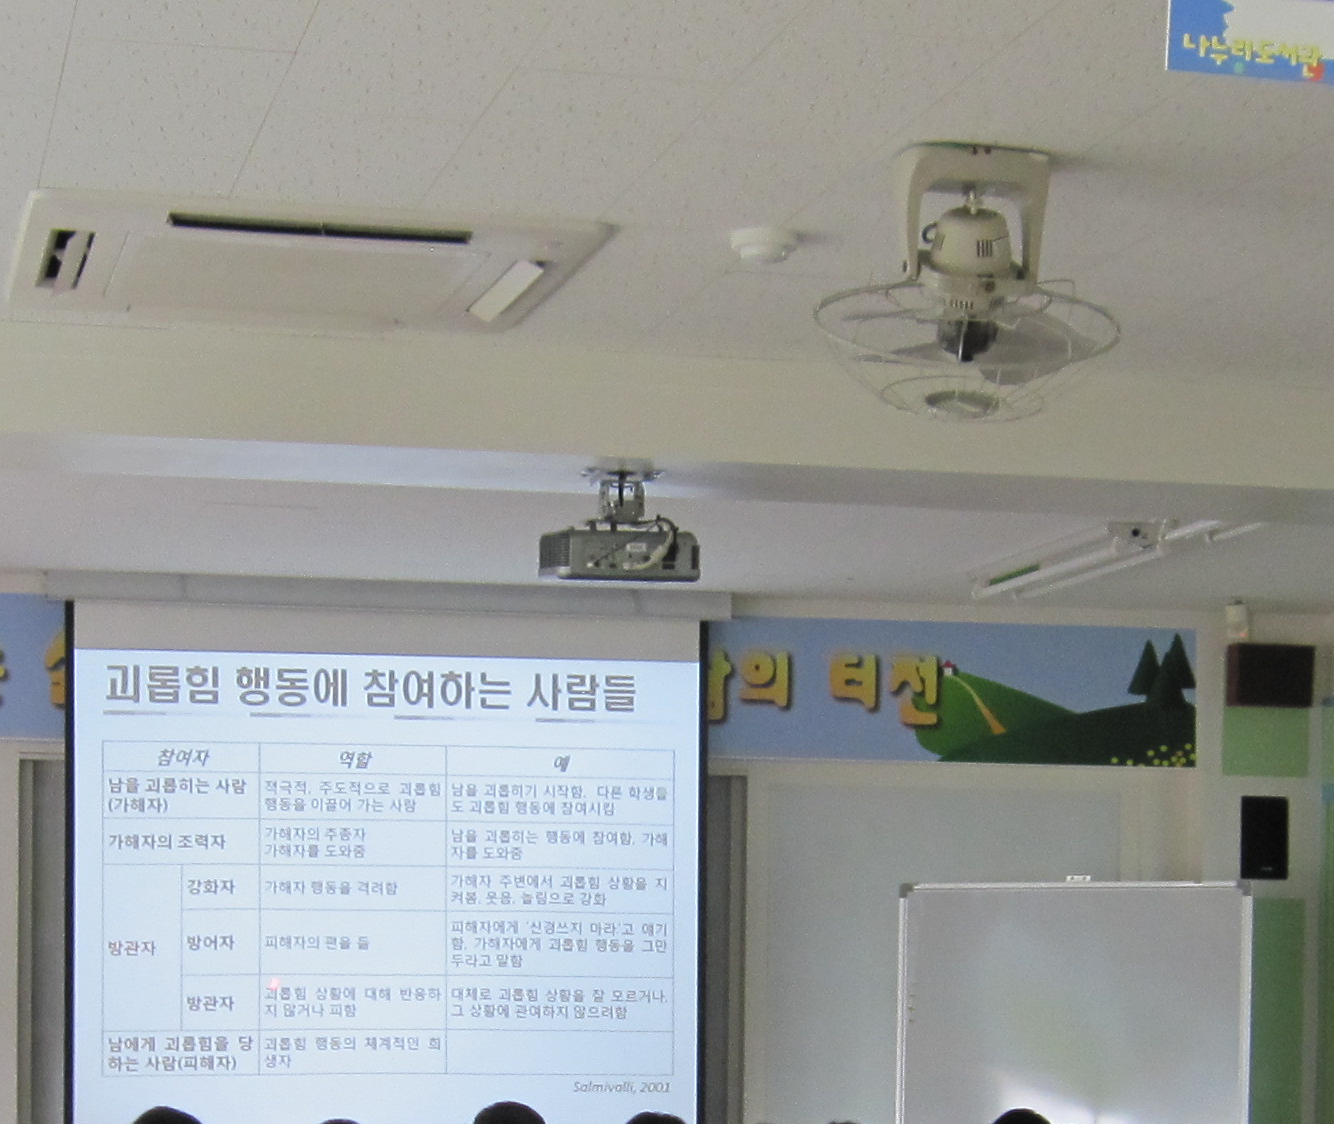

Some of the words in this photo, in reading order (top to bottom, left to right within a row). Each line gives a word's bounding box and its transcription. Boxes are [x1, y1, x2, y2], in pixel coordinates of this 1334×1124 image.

[106, 665, 218, 704] 괴롭힘
[236, 667, 347, 707] 행동에
[364, 669, 511, 710] 참여하는
[527, 673, 636, 712] 사람들
[829, 651, 939, 726] 터전
[158, 749, 210, 767] 참여자
[340, 751, 373, 769] 역할
[554, 756, 570, 772] 예
[109, 778, 139, 793] 남을
[145, 778, 209, 794] 괴롭히는
[216, 778, 246, 794] 사람
[319, 782, 390, 795] 주도적으로
[400, 783, 440, 796] 괴롭힘
[452, 784, 477, 797] 남을
[485, 784, 536, 798] 괴롭히기
[597, 786, 622, 799] 다른
[629, 786, 667, 800] 학생들
[108, 797, 168, 813] (가해자)
[265, 798, 306, 811] 행동을
[311, 798, 351, 812] 이끌어
[358, 799, 383, 812] 가는
[390, 799, 416, 813] 사람
[451, 801, 463, 812] 도
[470, 801, 509, 814] 괴롭힘
[516, 801, 555, 815] 행동에
[562, 802, 614, 816] 참여시킴
[265, 827, 319, 841] 가해자의
[452, 829, 477, 842] 남을
[486, 830, 538, 844] 괴롭히는
[546, 831, 584, 844] 행동에
[643, 833, 667, 846] 가해
[109, 834, 172, 850] 가해자의
[178, 834, 226, 850] 조력자
[266, 844, 319, 858] 가해자를
[452, 846, 477, 859] 자를
[187, 879, 235, 895] 강화자
[266, 881, 305, 894] 가해자
[311, 881, 351, 895] 행동을
[358, 881, 397, 895] 격려함
[452, 875, 491, 888] 가해자
[500, 875, 552, 888] 주변에서
[561, 876, 599, 889] 괴롭힘
[609, 876, 647, 890] 상황을
[656, 878, 667, 891] 지
[581, 893, 606, 906] 강화
[452, 921, 518, 934] 피해자에게
[108, 940, 156, 956] 방관자
[187, 935, 235, 951] 방어자
[265, 936, 319, 949] 피해자의
[325, 936, 351, 950] 편을
[475, 937, 541, 951] 가해자에게
[549, 938, 587, 952] 괴롭힘
[596, 939, 634, 952] 행동을
[642, 940, 667, 953] 그만
[451, 954, 491, 967] 두라고
[497, 954, 522, 968] 말함
[265, 987, 306, 1001] 괴롭힘
[316, 987, 355, 1001] 상황에
[365, 988, 390, 1001] 대해
[400, 988, 441, 1001] 반응하
[452, 988, 491, 1001] 대체로
[499, 988, 537, 1002] 괴롭힘
[546, 989, 584, 1002] 상황을
[593, 989, 604, 1002] 잘
[187, 996, 234, 1011] 방관자
[266, 1004, 276, 1017] 지
[284, 1004, 324, 1017] 않거나
[330, 1004, 356, 1017] 피함
[451, 1005, 464, 1016] 그
[470, 1005, 509, 1018] 상황에
[516, 1005, 568, 1019] 관여하지
[109, 1037, 155, 1052] 남에게
[165, 1036, 229, 1051] 괴롭힘을
[239, 1036, 254, 1051] 당
[265, 1037, 306, 1051] 괴롭힘
[315, 1037, 356, 1050] 행동의
[365, 1037, 419, 1050] 체계적인
[428, 1037, 440, 1050] 희
[108, 1056, 139, 1072] 하는
[146, 1056, 236, 1071] 사람(피해자)
[265, 1055, 291, 1068] 생자
[573, 1081, 636, 1094] Salmivalli,
